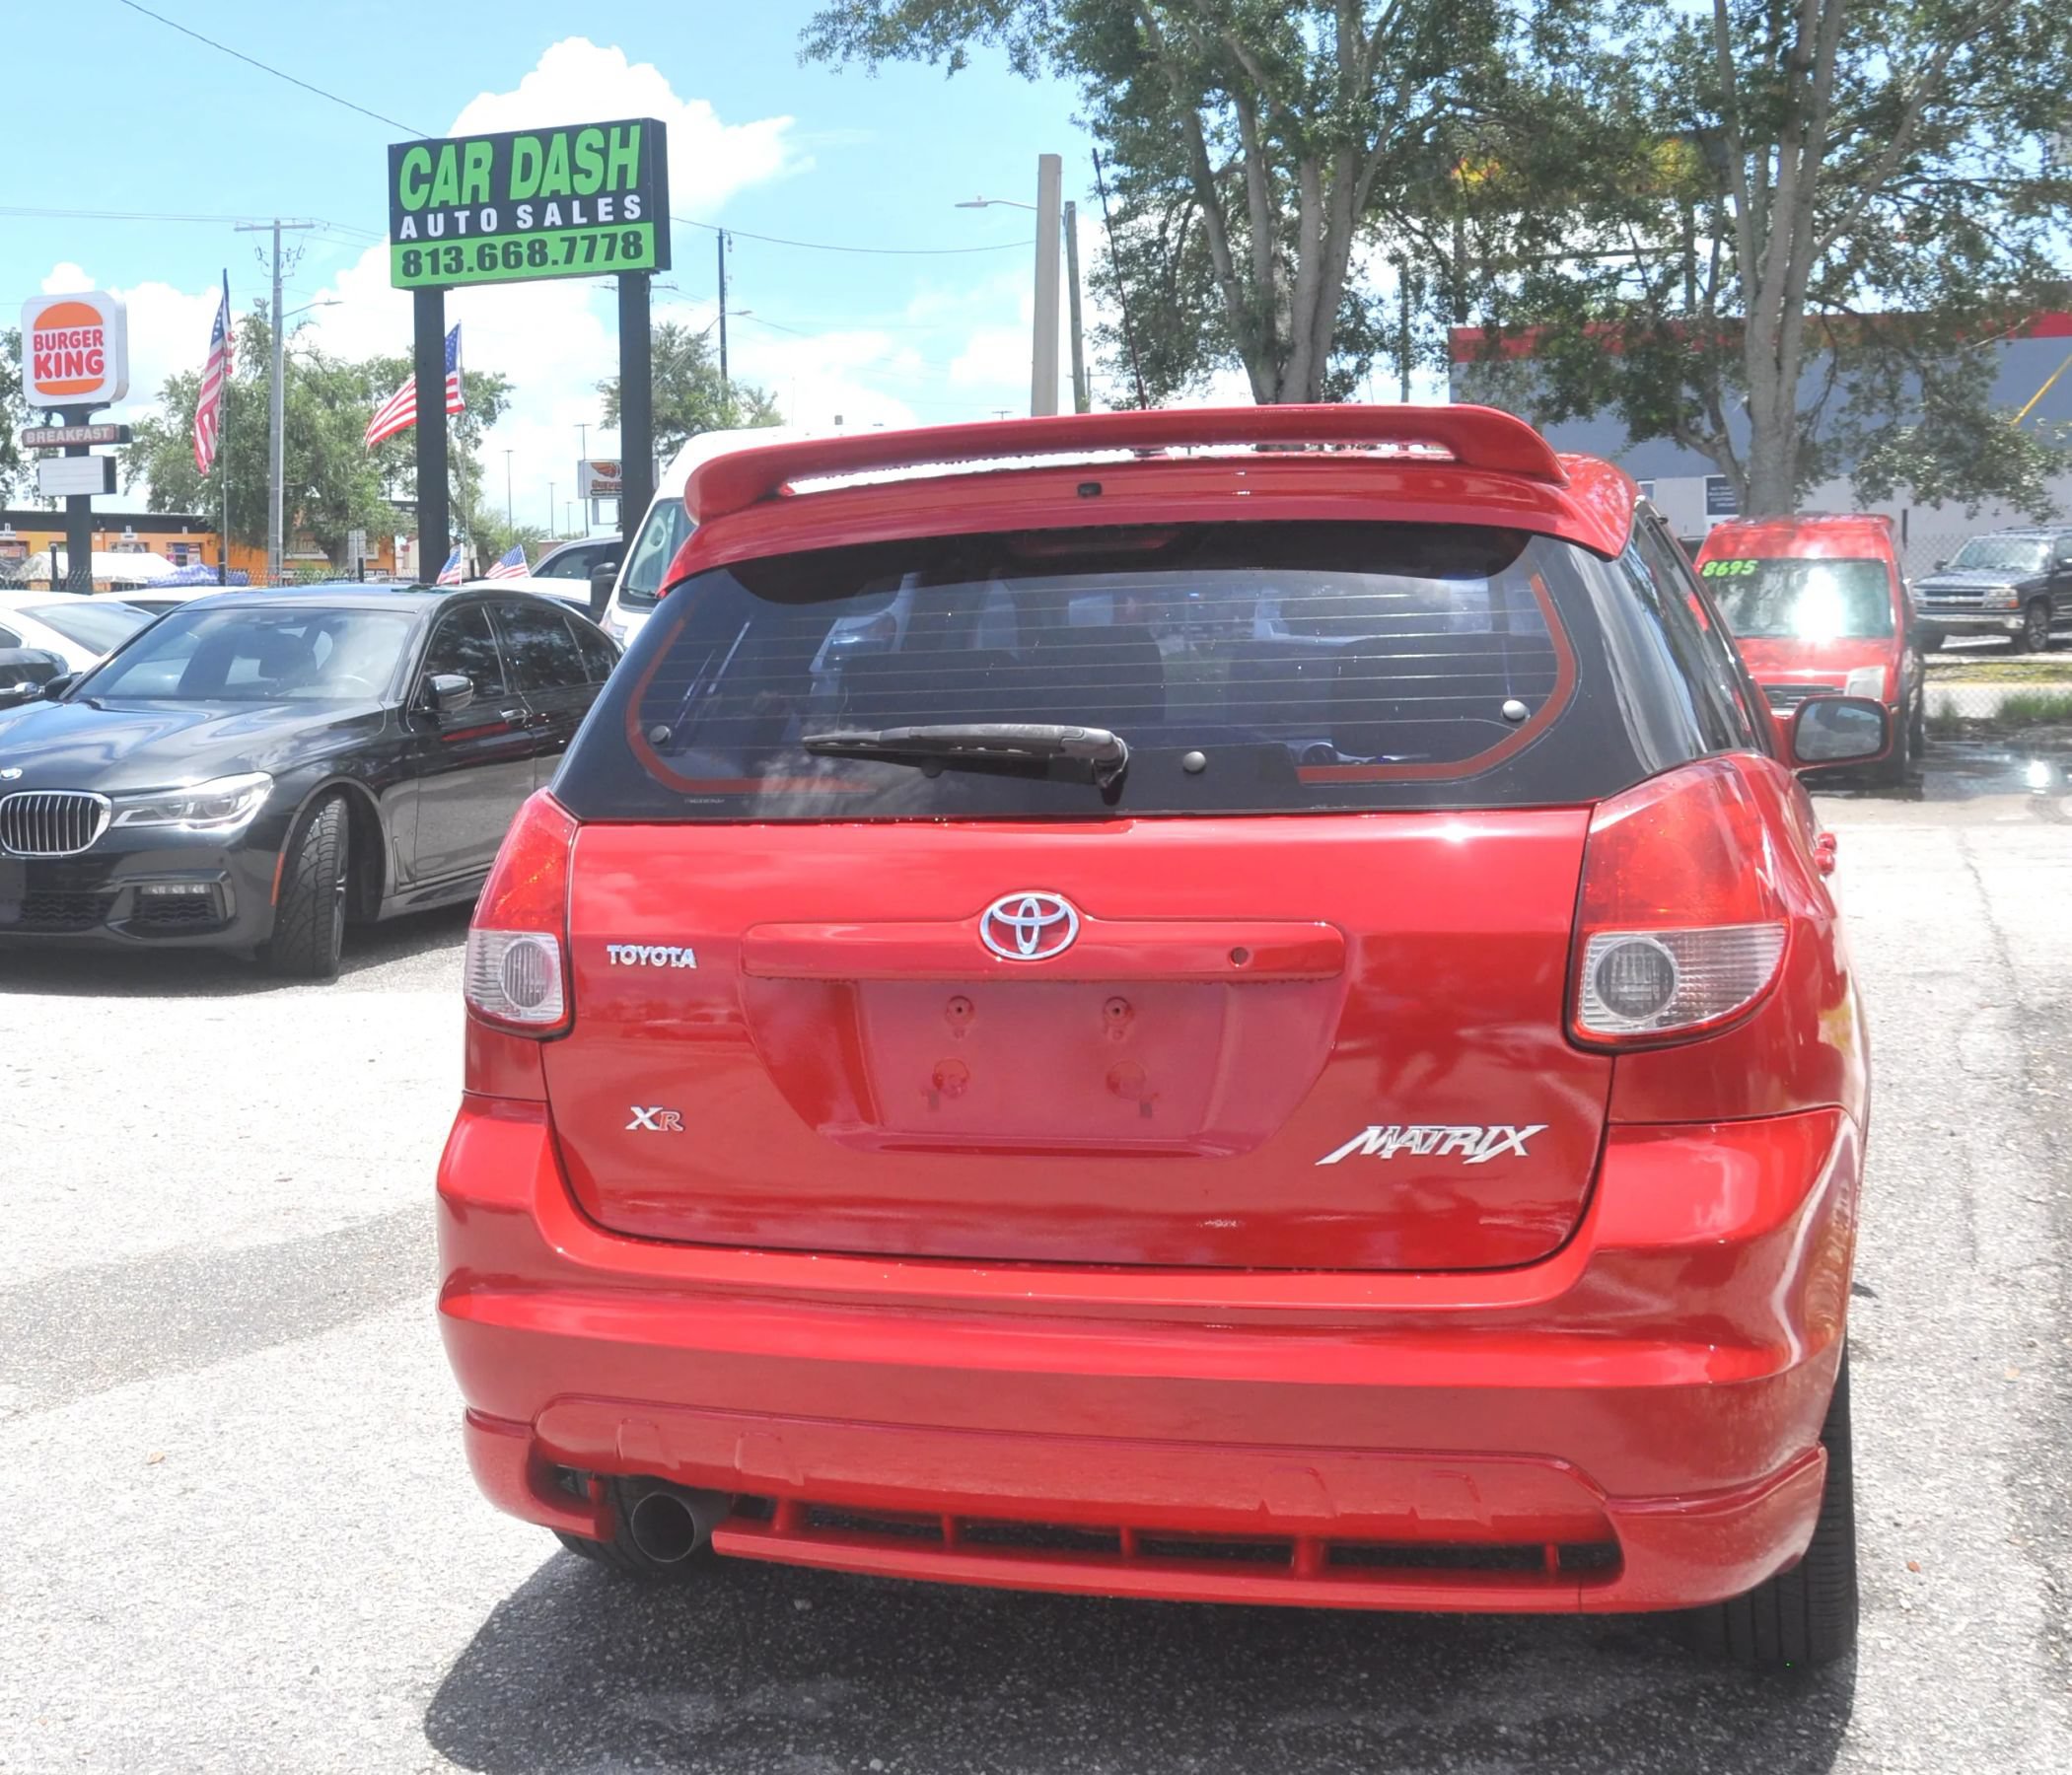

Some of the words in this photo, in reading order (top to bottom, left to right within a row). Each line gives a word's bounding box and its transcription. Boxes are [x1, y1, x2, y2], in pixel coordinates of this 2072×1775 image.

[399, 141, 493, 211] CAR
[509, 124, 641, 201] DASH
[399, 207, 498, 240] AUTO
[516, 194, 642, 229] SALES
[401, 231, 644, 278] 813.668.7778
[34, 328, 104, 353] BURGER
[34, 349, 105, 380] KING
[27, 427, 110, 444] BREAKFAST
[1702, 559, 1759, 578] 8695
[607, 944, 698, 968] TOYOTA
[624, 1105, 684, 1132] XR
[1314, 1124, 1549, 1167] MATRIX
